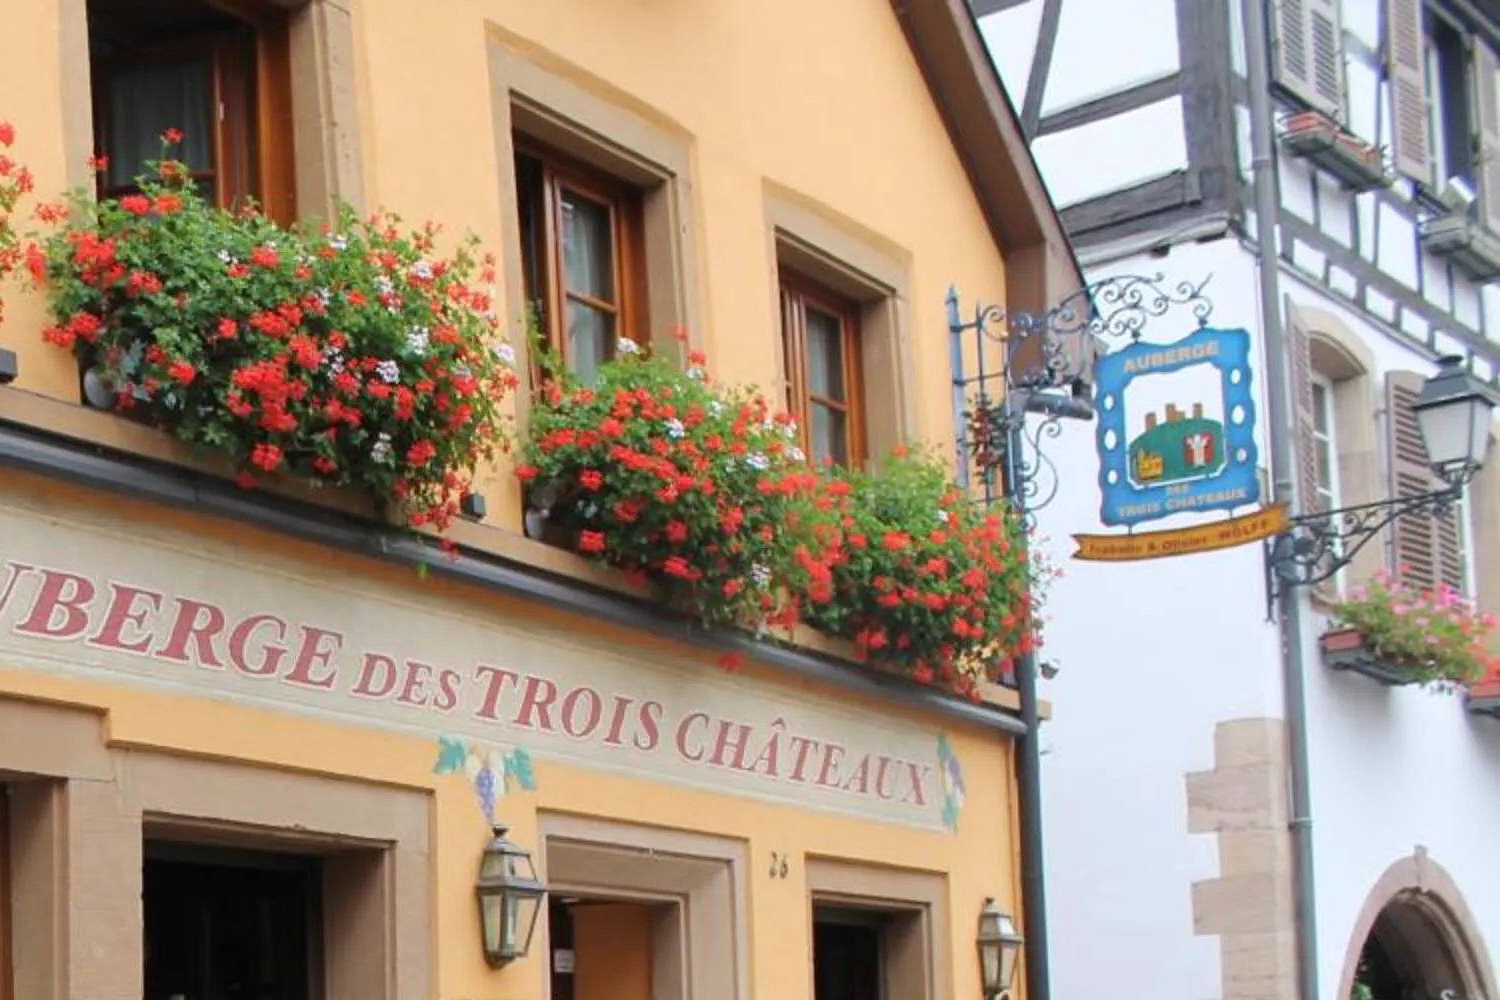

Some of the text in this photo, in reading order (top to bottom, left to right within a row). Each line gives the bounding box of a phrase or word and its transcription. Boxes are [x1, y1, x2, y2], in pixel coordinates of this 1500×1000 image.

[1123, 341, 1219, 373] AUBERGE
[353, 652, 462, 713] DES
[473, 665, 665, 752] TROIS
[675, 712, 933, 807] CHÂTEAUX
